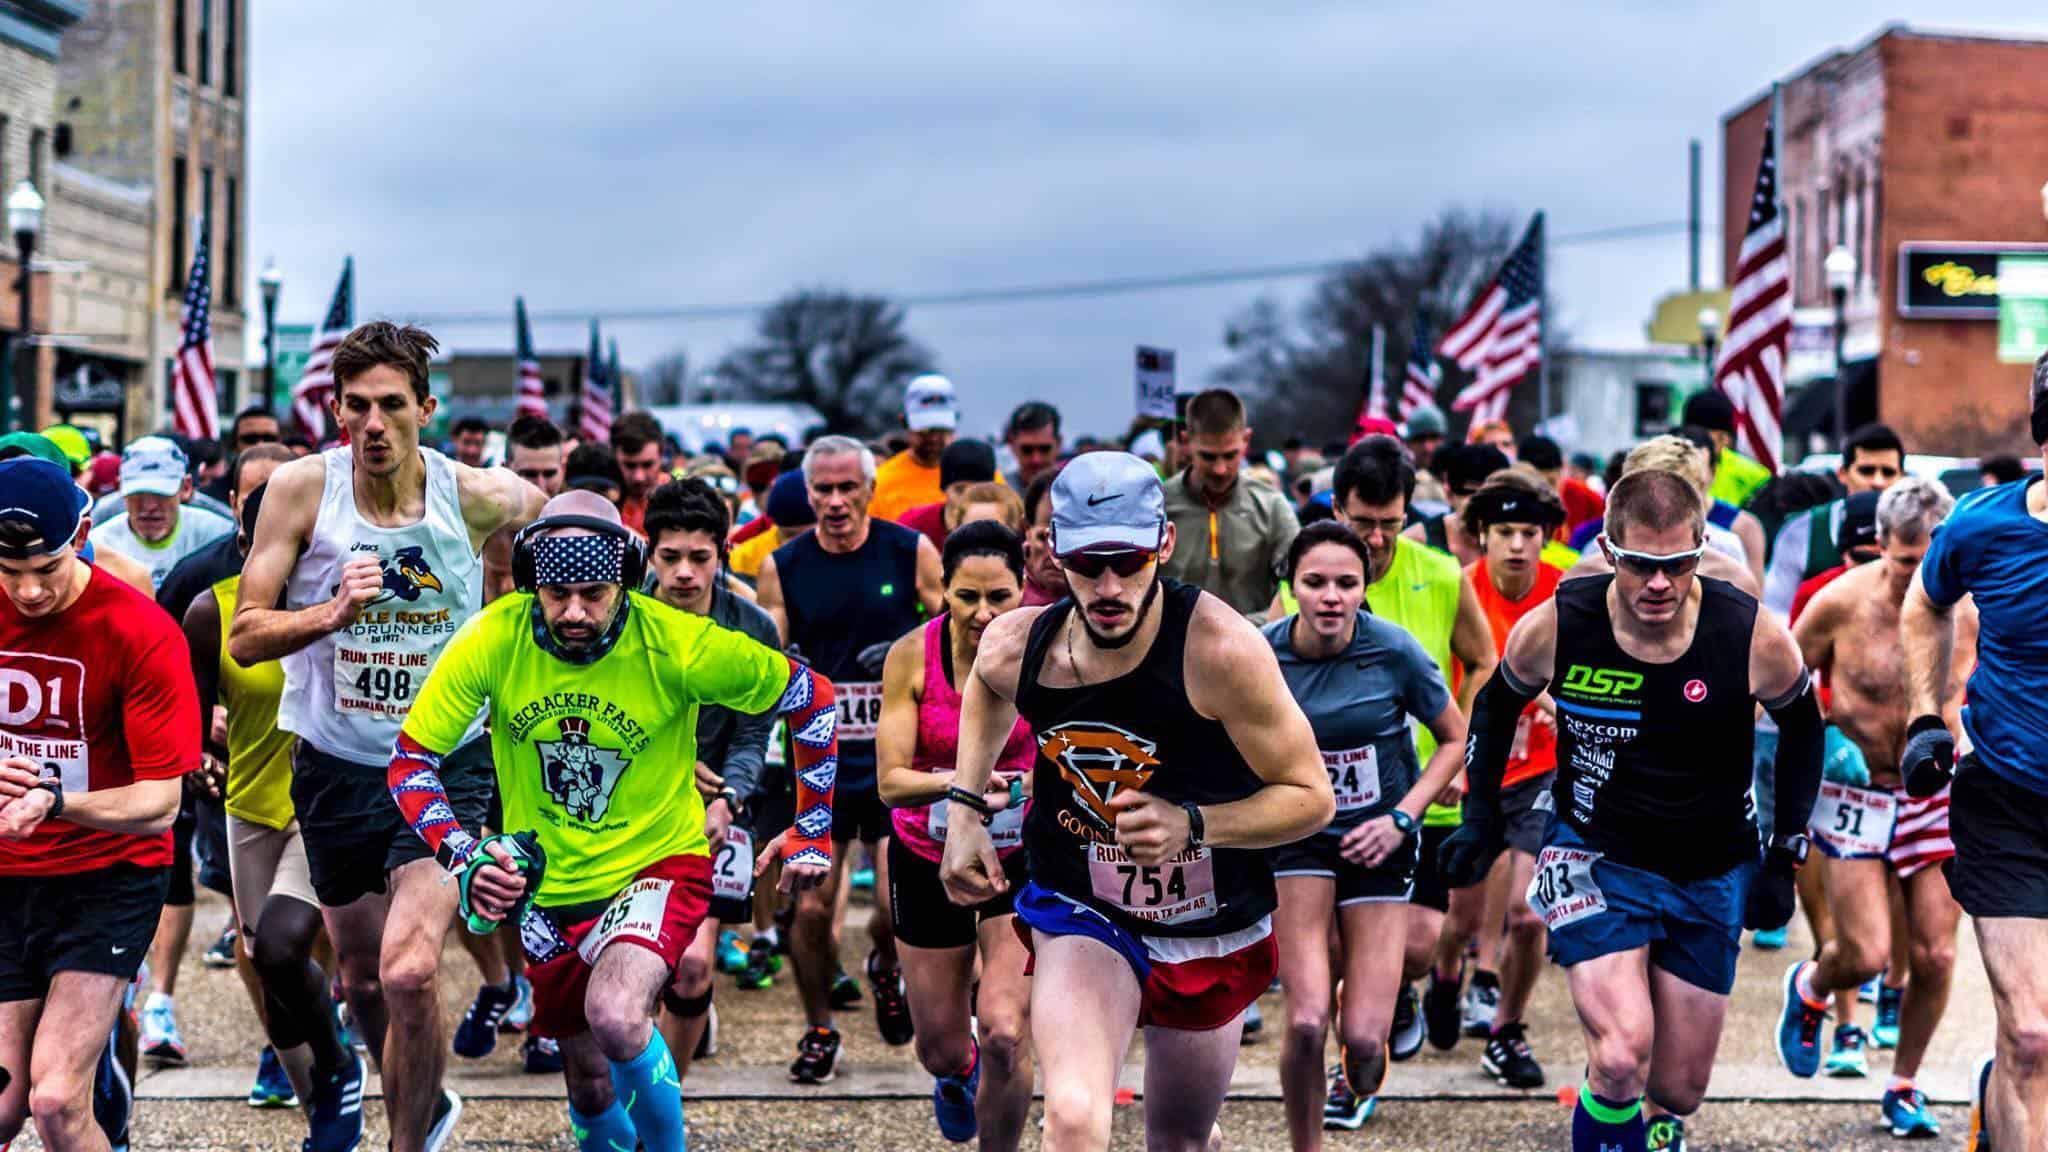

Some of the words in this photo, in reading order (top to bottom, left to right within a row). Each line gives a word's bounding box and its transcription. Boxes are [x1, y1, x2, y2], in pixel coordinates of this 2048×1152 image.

[355, 610, 391, 624] TLE
[395, 608, 452, 625] ROCK
[341, 621, 455, 636] ADRUNNERS
[340, 648, 368, 664] RUN
[371, 652, 396, 665] THE
[399, 654, 428, 666] LINE
[355, 667, 411, 701] 498
[1562, 664, 1644, 695] DSP
[602, 702, 645, 739] FAST
[839, 698, 881, 725] 148
[17, 741, 42, 757] THE
[47, 745, 79, 759] LINE
[1344, 749, 1369, 764] LINE
[1834, 802, 1864, 837] 51
[714, 844, 736, 877] 2
[1096, 845, 1129, 862] RUN
[633, 881, 661, 894] LINE
[1117, 865, 1187, 905] 754
[600, 897, 633, 934] 85
[1161, 907, 1174, 918] TX
[1174, 902, 1191, 914] and
[1193, 896, 1207, 909] AR
[1569, 900, 1585, 913] and
[623, 921, 639, 930] and
[640, 921, 652, 932] AR
